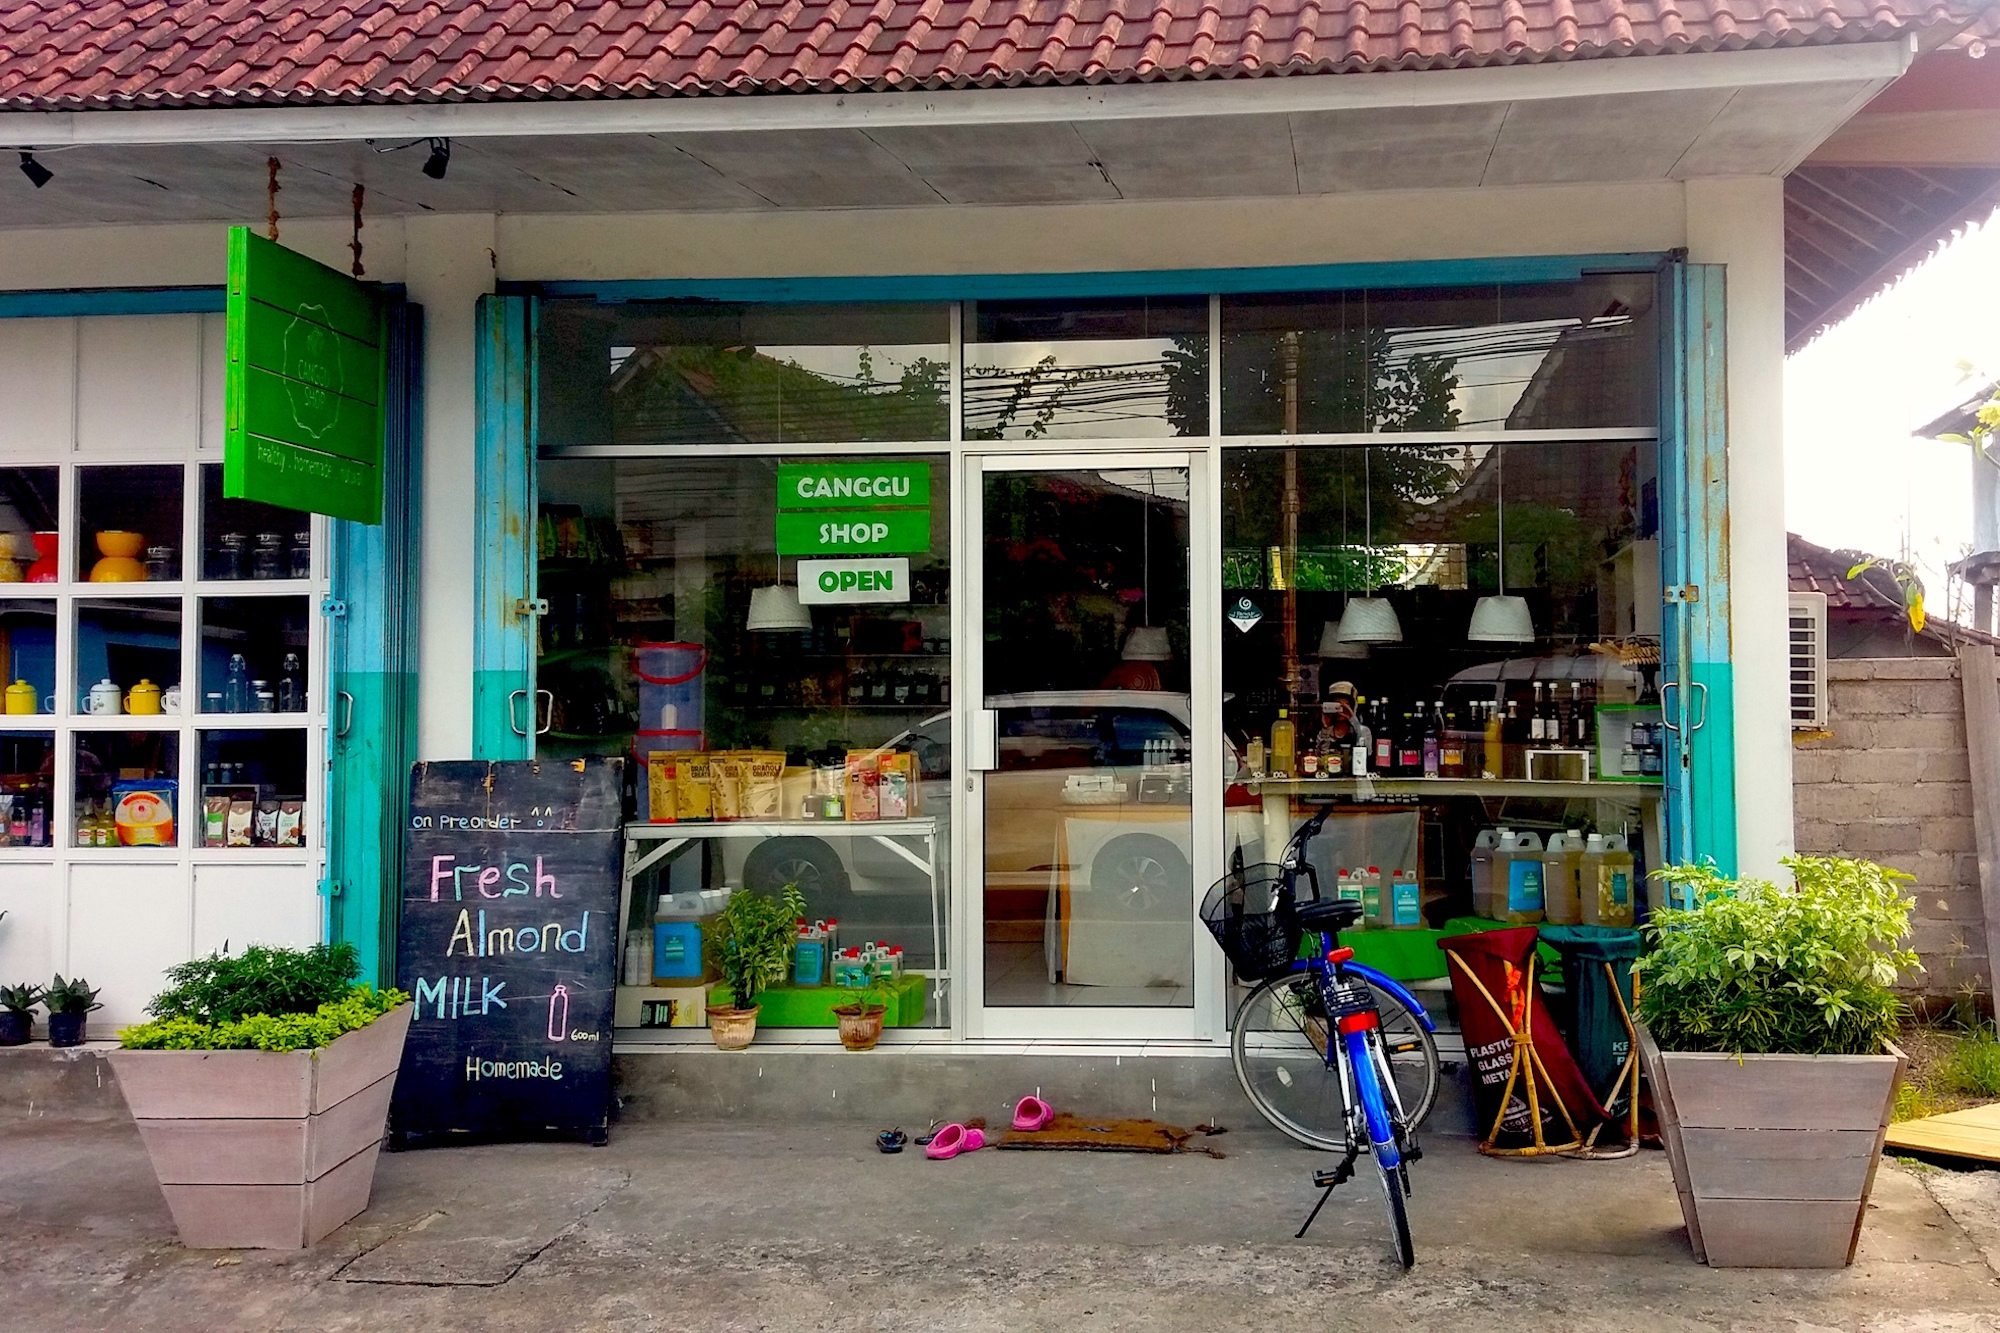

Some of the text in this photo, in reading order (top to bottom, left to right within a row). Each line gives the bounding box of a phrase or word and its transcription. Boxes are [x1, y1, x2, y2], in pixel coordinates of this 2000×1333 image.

[797, 476, 909, 498] CANGGU
[819, 523, 889, 544] SHOP
[818, 570, 893, 593] OPEN
[412, 814, 433, 829] on
[430, 854, 563, 903] Fresh
[446, 908, 590, 958] Almond
[413, 975, 508, 1021] MILK
[570, 1029, 600, 1042] 600ml
[1470, 1037, 1514, 1058] PLASTIC
[466, 1055, 563, 1081] Homemade
[1477, 1052, 1514, 1072] GLASS
[1481, 1068, 1520, 1085] META
